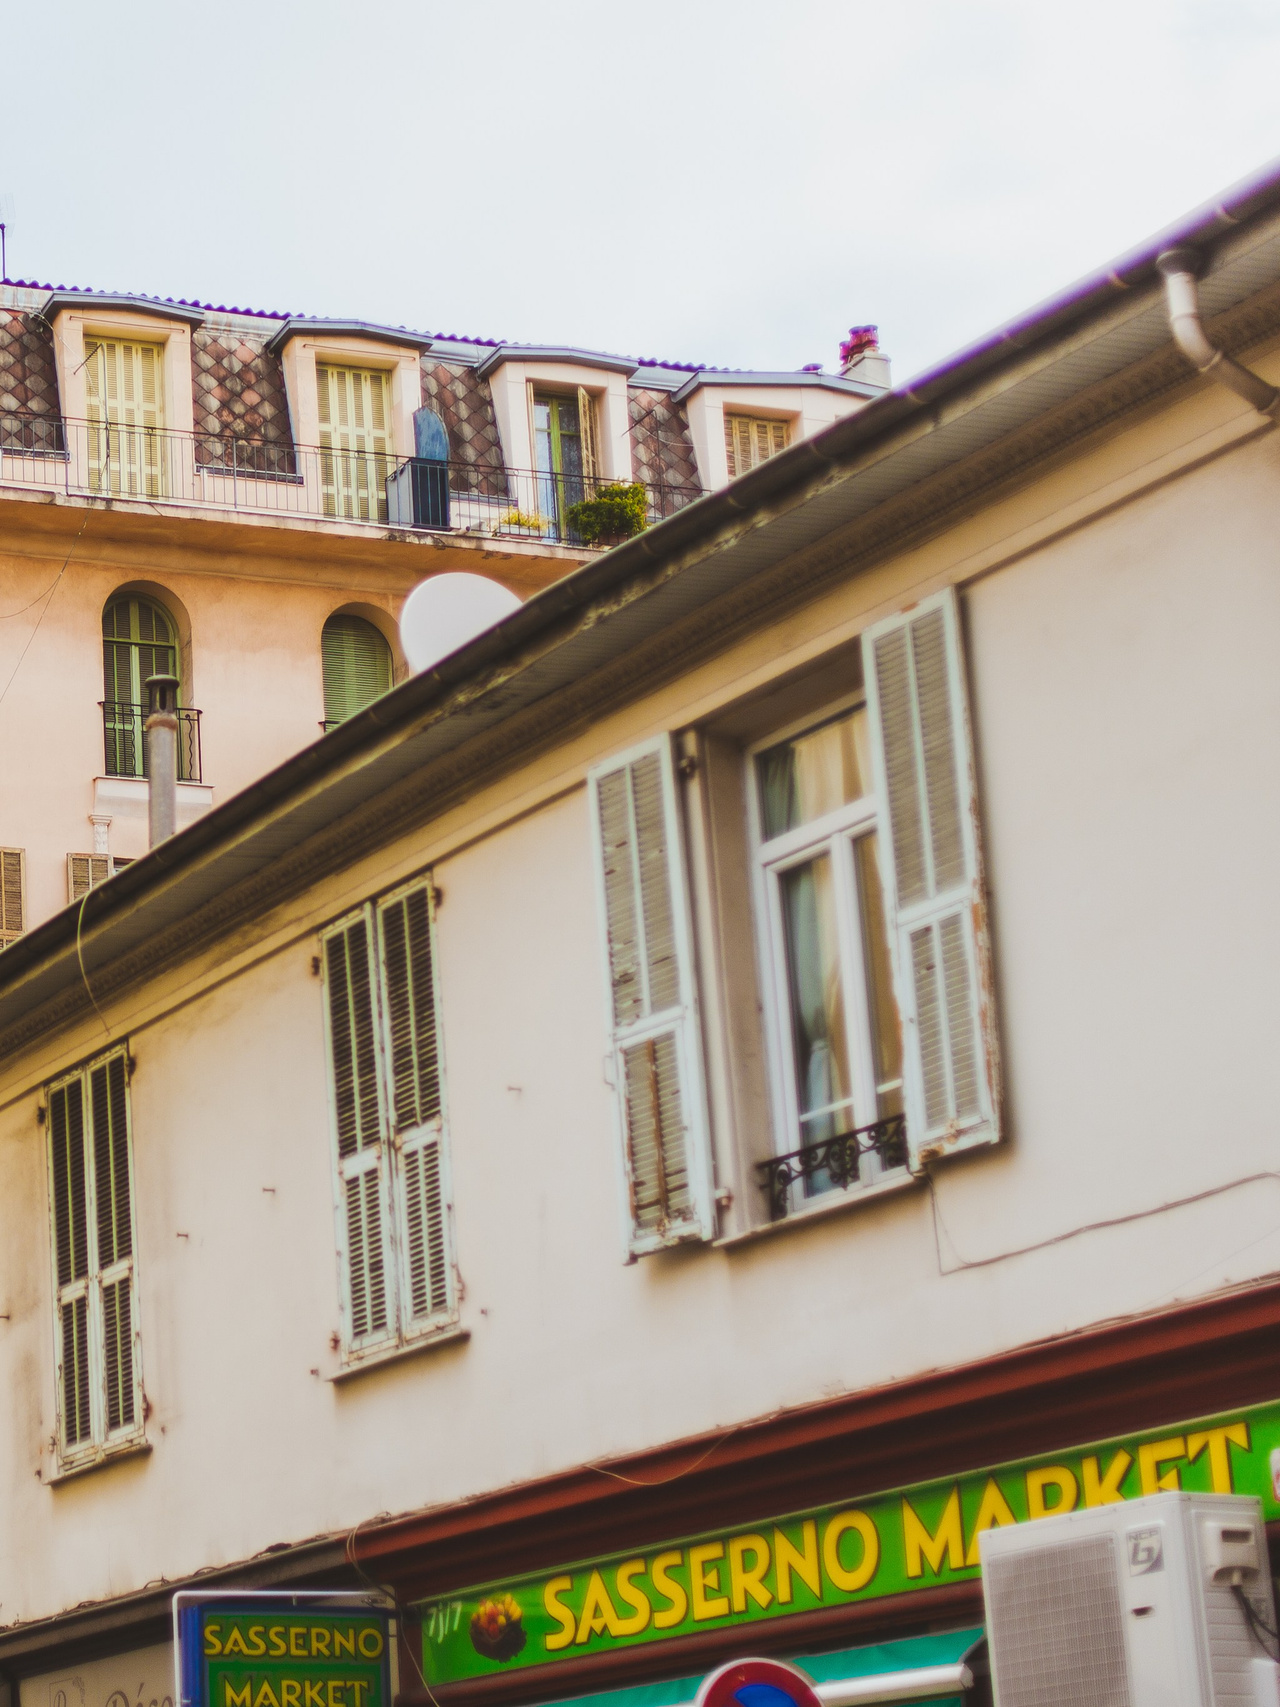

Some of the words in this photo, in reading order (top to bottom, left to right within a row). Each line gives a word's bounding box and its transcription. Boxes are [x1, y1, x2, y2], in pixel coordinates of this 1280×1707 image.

[544, 1509, 880, 1652] SASSERNO
[901, 1421, 1251, 1579] MARKET
[204, 1624, 384, 1659] SASSERNO
[223, 1676, 369, 1707] MARKET
